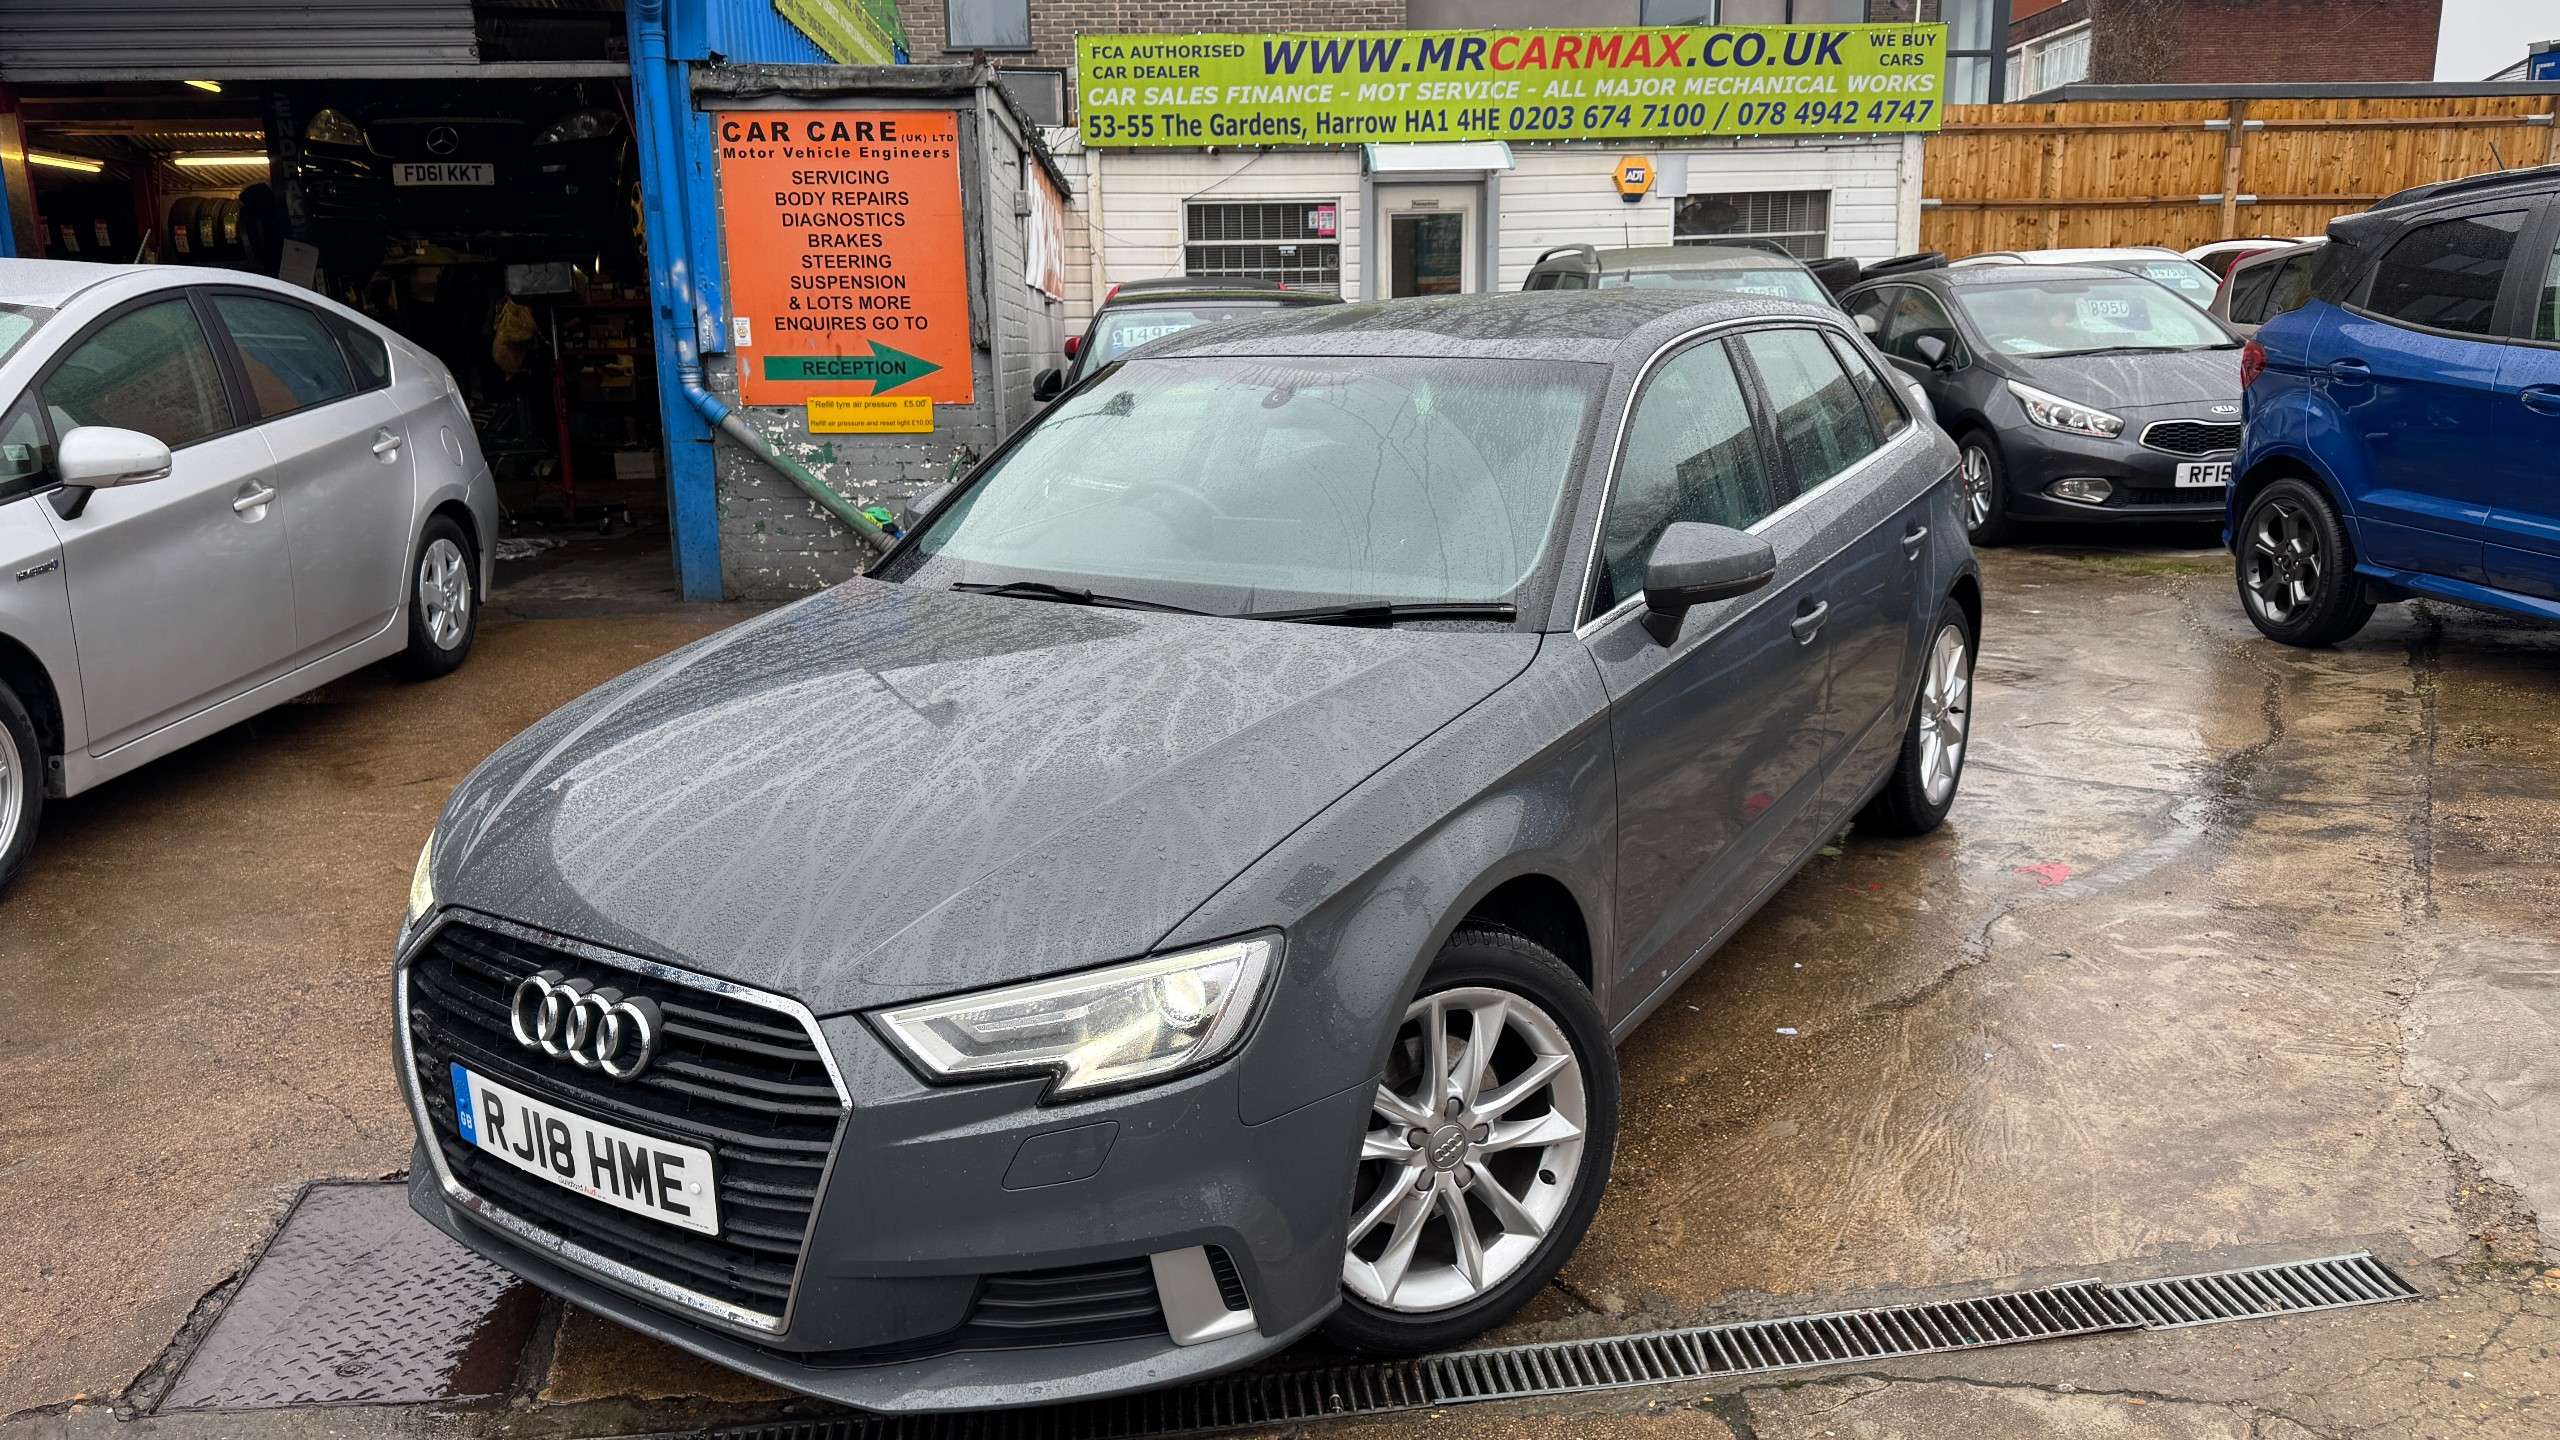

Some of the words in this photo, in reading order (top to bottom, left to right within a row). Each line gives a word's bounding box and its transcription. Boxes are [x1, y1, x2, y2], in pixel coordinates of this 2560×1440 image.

[1870, 34, 1896, 47] WE
[1902, 34, 1937, 47] BUY
[1092, 45, 1124, 59] FCA
[1130, 44, 1245, 59] AUTHORISED
[1263, 31, 1850, 75] WWW.MRCARMAX.CO.UK
[1879, 53, 1924, 66] CARS
[1092, 66, 1127, 80] CAR
[1134, 65, 1200, 79] DEALER
[1088, 87, 1136, 106] CAR
[1144, 85, 1218, 105] SALES
[1226, 84, 1334, 104] FINANCE
[1357, 82, 1411, 102] MOT
[1416, 81, 1520, 101] SERVICE
[1543, 79, 1587, 98] ALL
[1594, 77, 1676, 98] MAJOR
[1683, 75, 1838, 96] MECHANICAL
[1848, 73, 1936, 93] WORKS
[1089, 114, 1154, 138] 53-55
[1161, 113, 1202, 137] The
[1210, 112, 1308, 140] Gardens,
[1316, 111, 1397, 134] Harrow
[1405, 109, 1449, 132] HA1
[1457, 108, 1501, 132] 4HE
[1509, 105, 1574, 131] 0203
[1583, 104, 1631, 129] 674
[1640, 102, 1705, 128] 7100
[1712, 102, 1730, 131] /
[1738, 101, 1787, 126] 078
[1794, 100, 1859, 125] 4942
[1867, 99, 1934, 124] 4747
[722, 121, 791, 143] CAR
[806, 120, 897, 142] CARE
[901, 134, 927, 144] (UK)
[932, 134, 954, 142] LTD
[723, 147, 774, 159] Motor
[784, 147, 851, 158] Vehicle
[860, 147, 950, 160] Engineers
[404, 165, 443, 182] FD61
[447, 165, 482, 182] KKT
[792, 170, 889, 184] SERVICING
[1625, 169, 1645, 182] ADT
[775, 192, 826, 206] BODY
[832, 191, 909, 206] REPAIRS
[782, 213, 905, 227] DIAGNOSTICS
[808, 234, 882, 248] BRAKES
[802, 254, 892, 269] STEERING
[791, 275, 906, 289] SUSPENSION
[789, 296, 801, 310] &
[807, 296, 853, 310] LOTS
[859, 296, 911, 310] MORE
[775, 316, 867, 331] ENQUIRES
[872, 316, 899, 330] GO
[904, 316, 928, 330] TO
[802, 360, 907, 375] RECEPTION
[836, 401, 850, 410] tyre
[2212, 405, 2238, 413] KIA
[2189, 465, 2232, 483] RF15
[460, 1111, 473, 1129] GB
[481, 1088, 576, 1178] RJ18
[585, 1130, 691, 1217] HME
